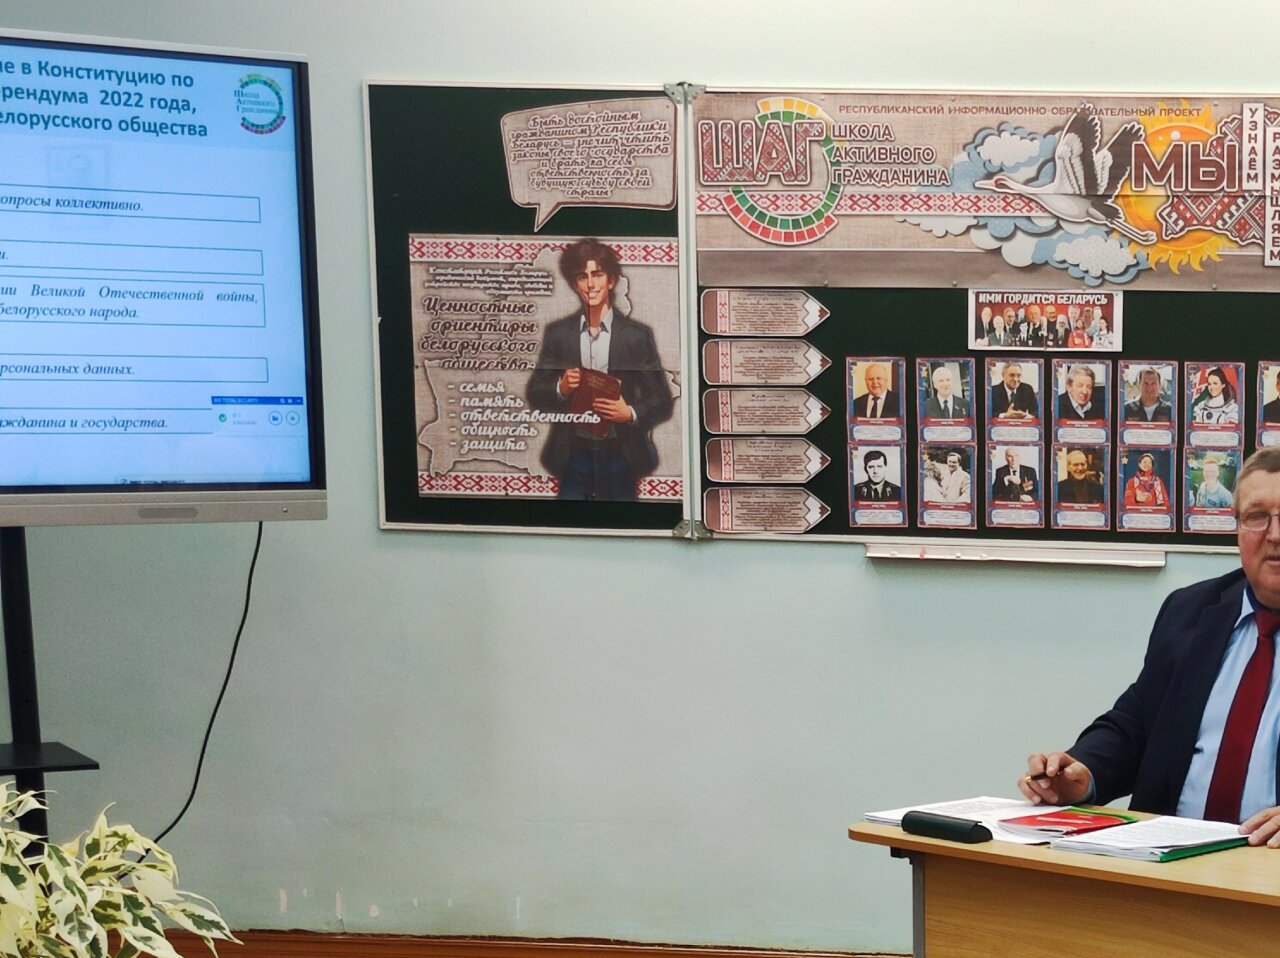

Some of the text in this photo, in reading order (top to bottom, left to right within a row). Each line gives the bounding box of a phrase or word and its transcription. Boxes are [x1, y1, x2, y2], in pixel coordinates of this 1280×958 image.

[21, 62, 32, 75] в
[38, 60, 166, 87] Конституцию
[171, 74, 194, 88] по
[0, 86, 196, 115] рендума 2022 года,
[838, 104, 945, 115] РЕСПУБЛИКАНСКИЙ
[1159, 107, 1202, 118] ПРОЕКТ
[118, 116, 208, 137] общества
[831, 123, 894, 140] ШКОЛА
[699, 120, 826, 185] ШАГ
[831, 146, 937, 163] АКТИВНОГО
[1132, 142, 1239, 191] МЫ
[831, 167, 951, 187] ГРАЖДАНИНА
[0, 195, 51, 209] опросы
[30, 284, 86, 298] Великой
[99, 285, 204, 301] Отечественной
[216, 290, 259, 304] войны,
[978, 293, 1108, 305] ИМИ ГОРДИТСЯ БЕЛАРУСЬ
[89, 305, 140, 321] народа.
[423, 297, 536, 317] Ценностные
[430, 317, 537, 338] ориентиры
[420, 335, 538, 358] белорусского
[82, 362, 136, 376] данных.
[459, 381, 505, 393] семья
[460, 394, 524, 408] память
[0, 415, 169, 432] жданина и государства.
[460, 408, 602, 425] ответственность
[460, 422, 538, 438] общность
[460, 438, 527, 454] защита
